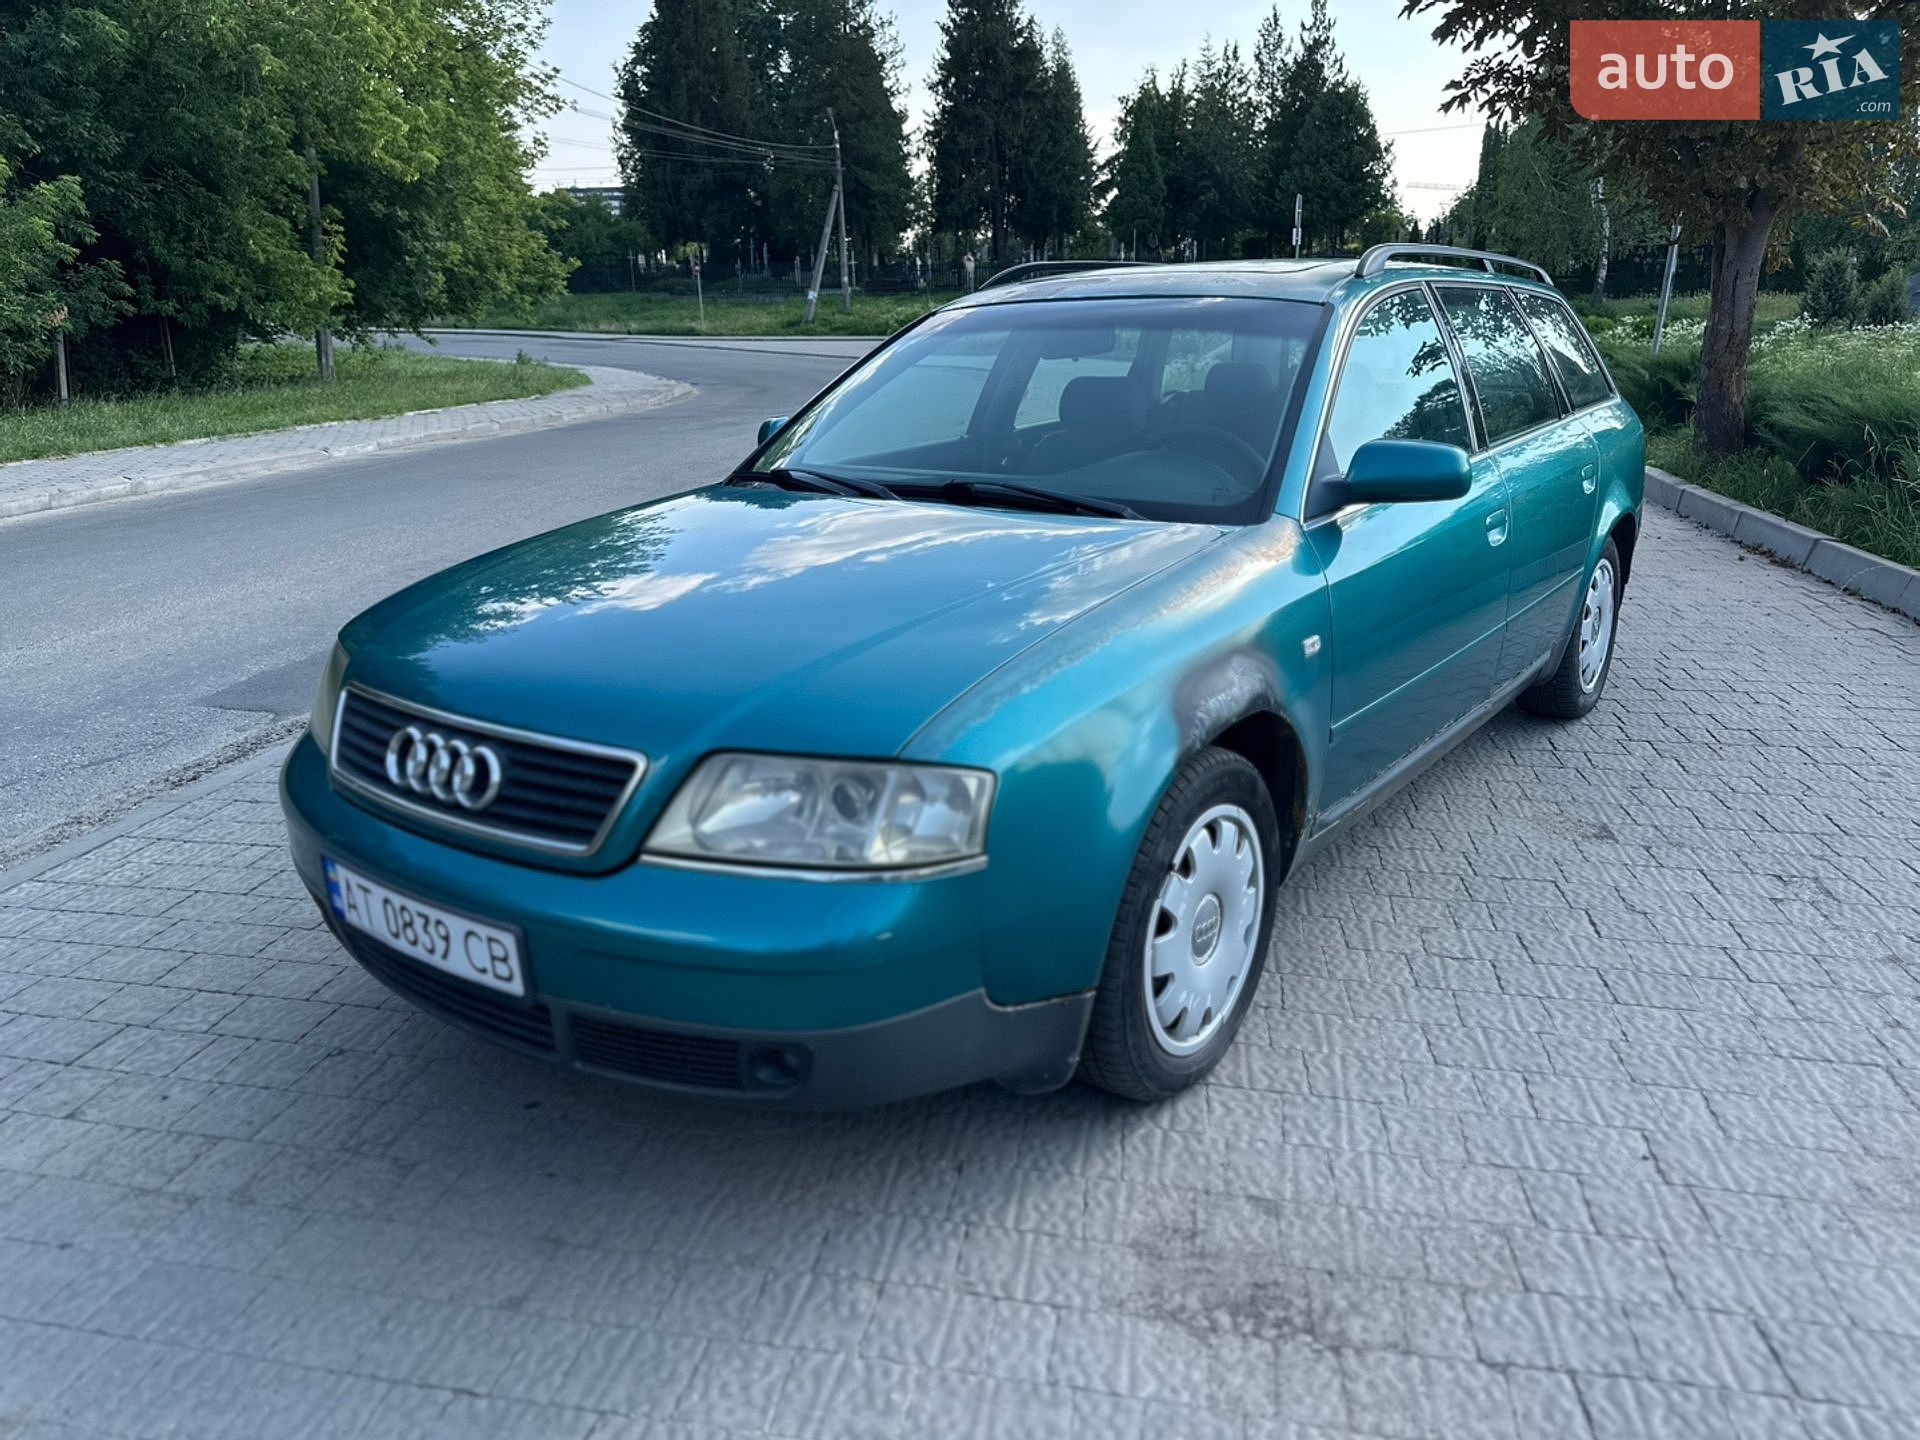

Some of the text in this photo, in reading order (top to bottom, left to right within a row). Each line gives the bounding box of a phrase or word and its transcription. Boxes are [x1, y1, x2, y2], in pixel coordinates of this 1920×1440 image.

[344, 876, 514, 982] AT 0839 CB
